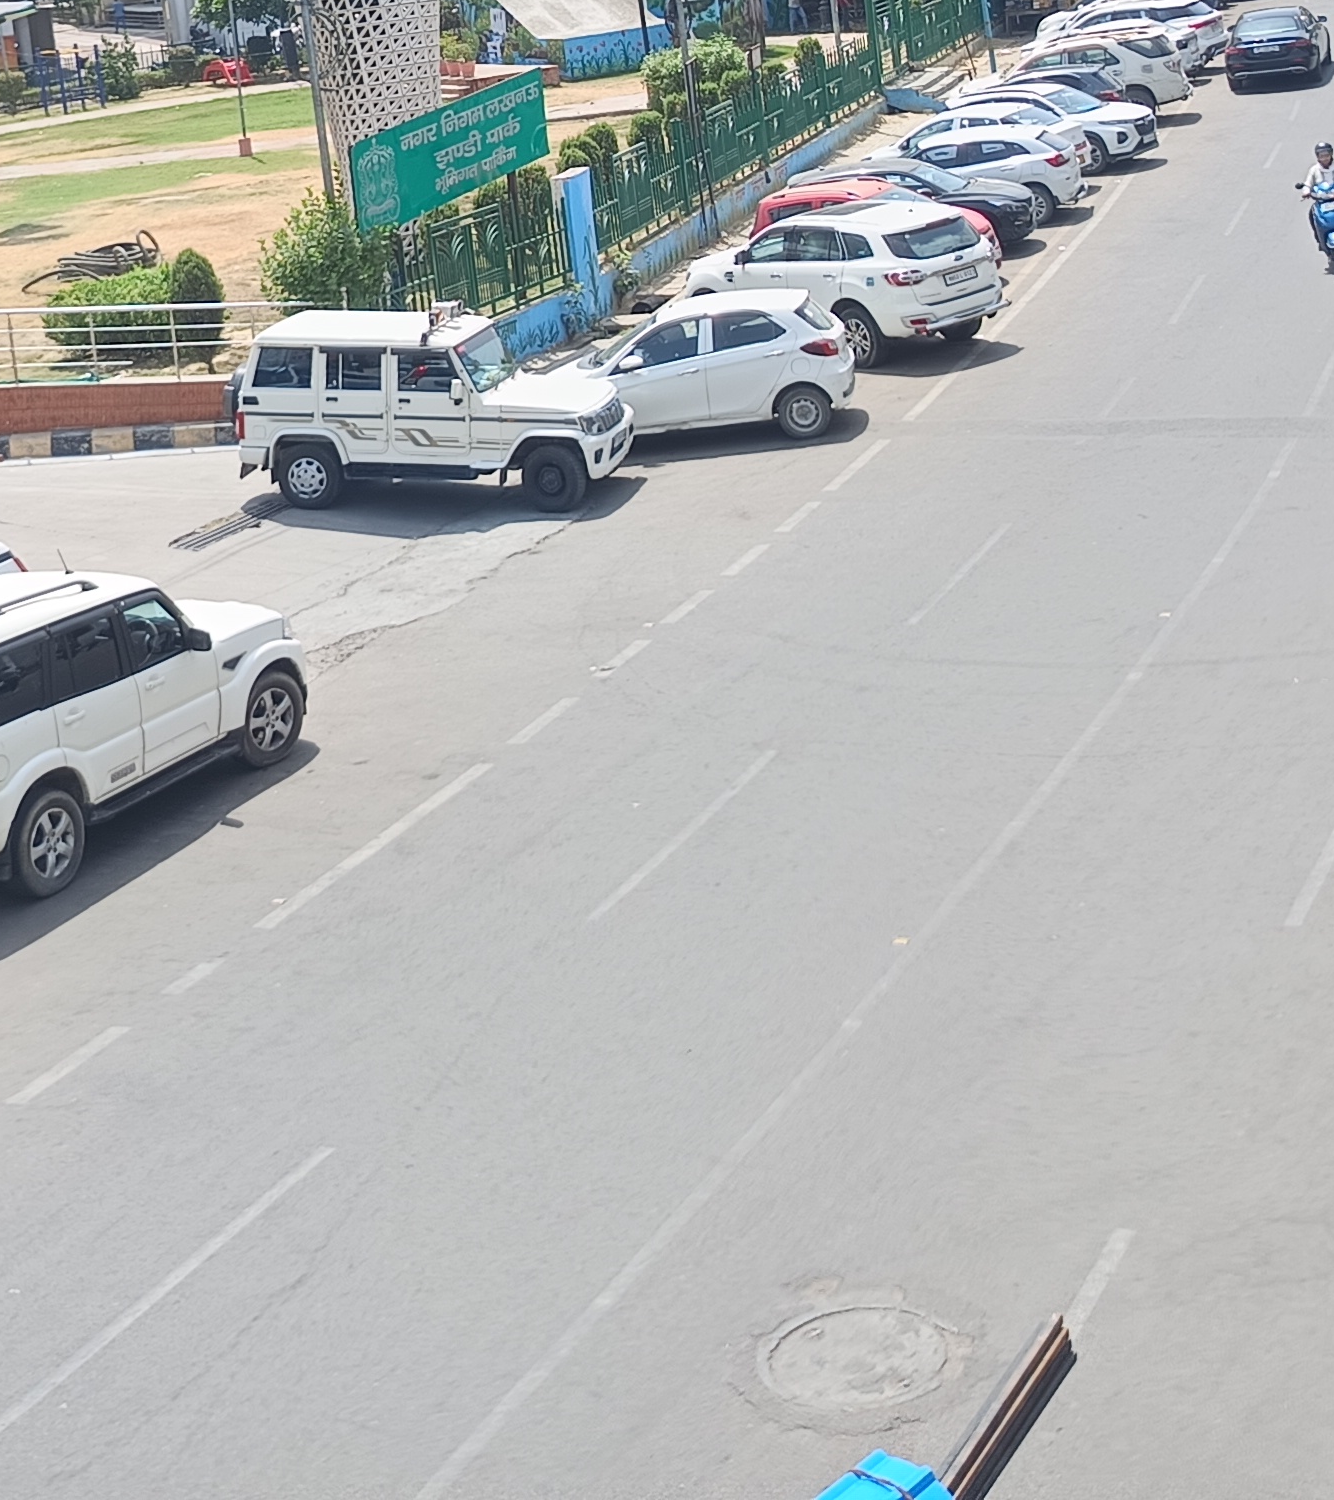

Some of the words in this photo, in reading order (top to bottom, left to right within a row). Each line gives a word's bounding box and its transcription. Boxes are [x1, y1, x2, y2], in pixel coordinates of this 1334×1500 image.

[400, 125, 437, 151] नगर
[439, 102, 485, 139] निगम
[485, 81, 540, 119] लखनऊ
[434, 129, 482, 171] झण्डी
[485, 116, 521, 146] पार्क
[435, 163, 478, 195] भूमिगत
[480, 145, 517, 172] पार्किंग
